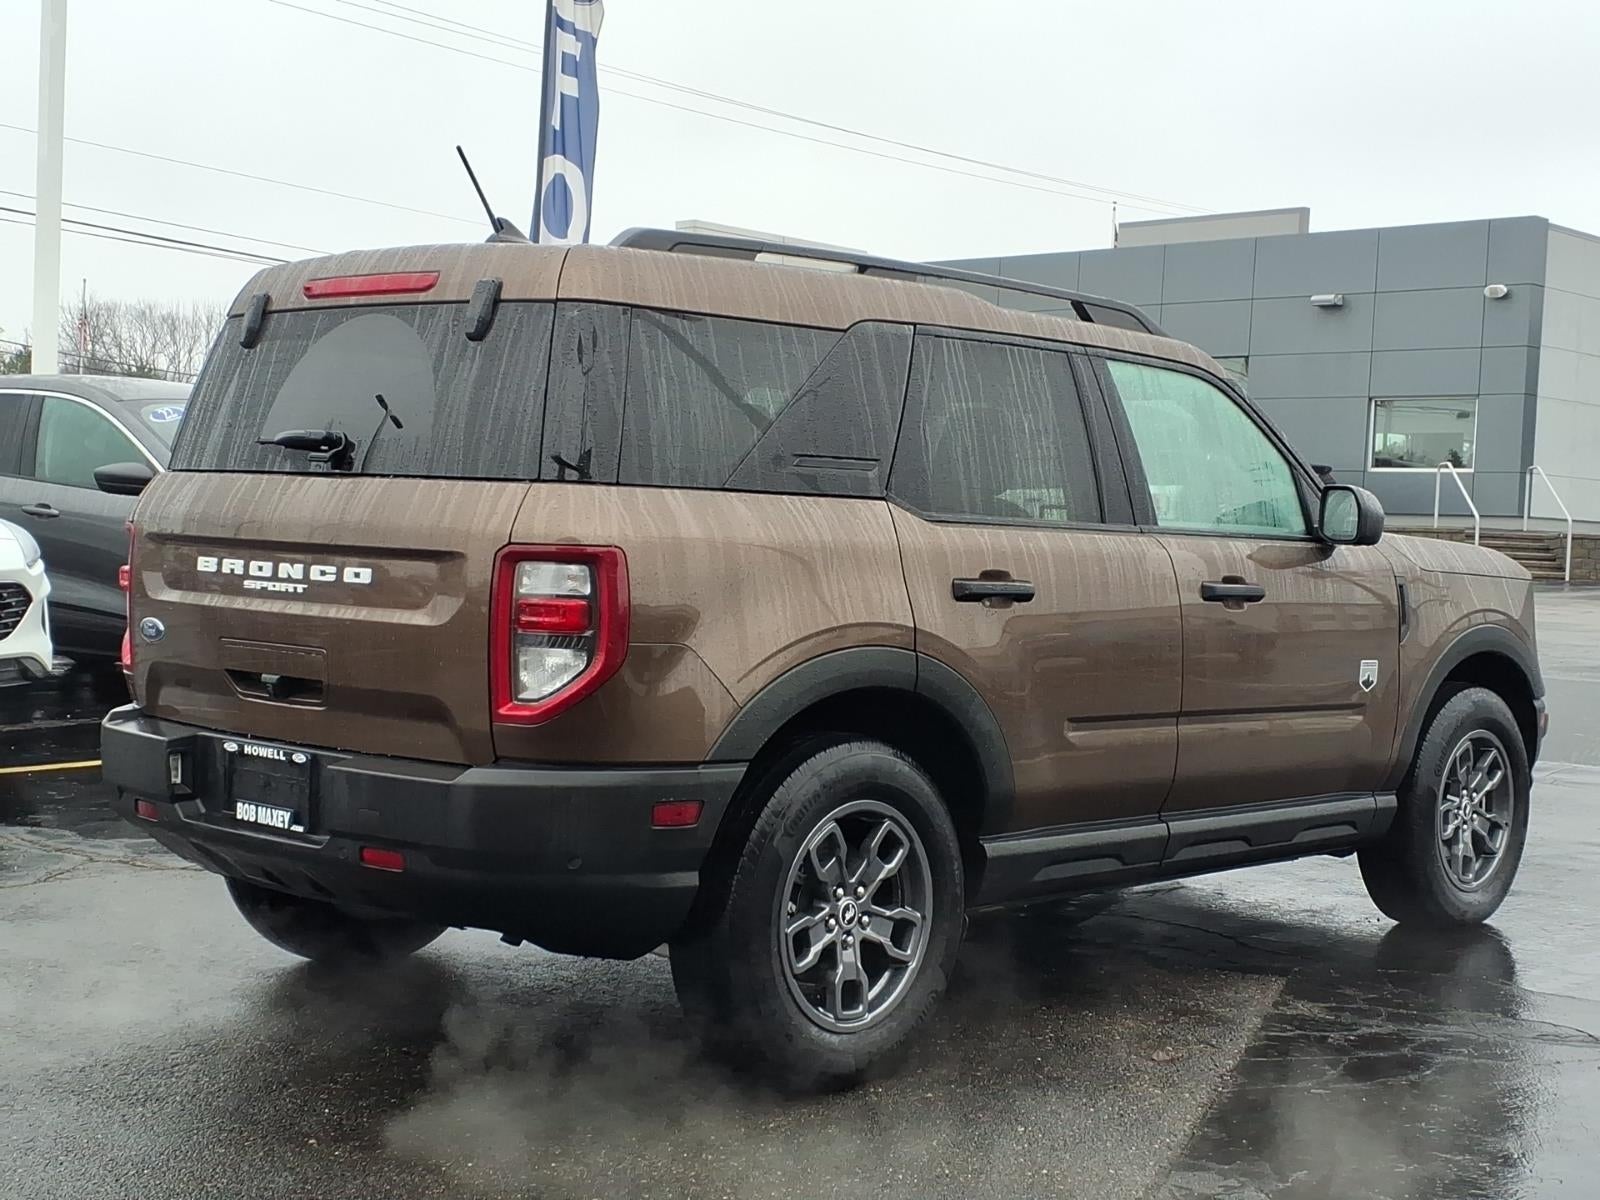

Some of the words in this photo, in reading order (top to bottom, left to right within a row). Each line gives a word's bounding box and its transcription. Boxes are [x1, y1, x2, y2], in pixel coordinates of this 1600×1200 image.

[196, 556, 372, 584] BRONCO
[243, 580, 308, 593] SPORT
[244, 744, 286, 760] HOWELL
[236, 802, 256, 822] BOB
[257, 806, 291, 829] MAXEY
